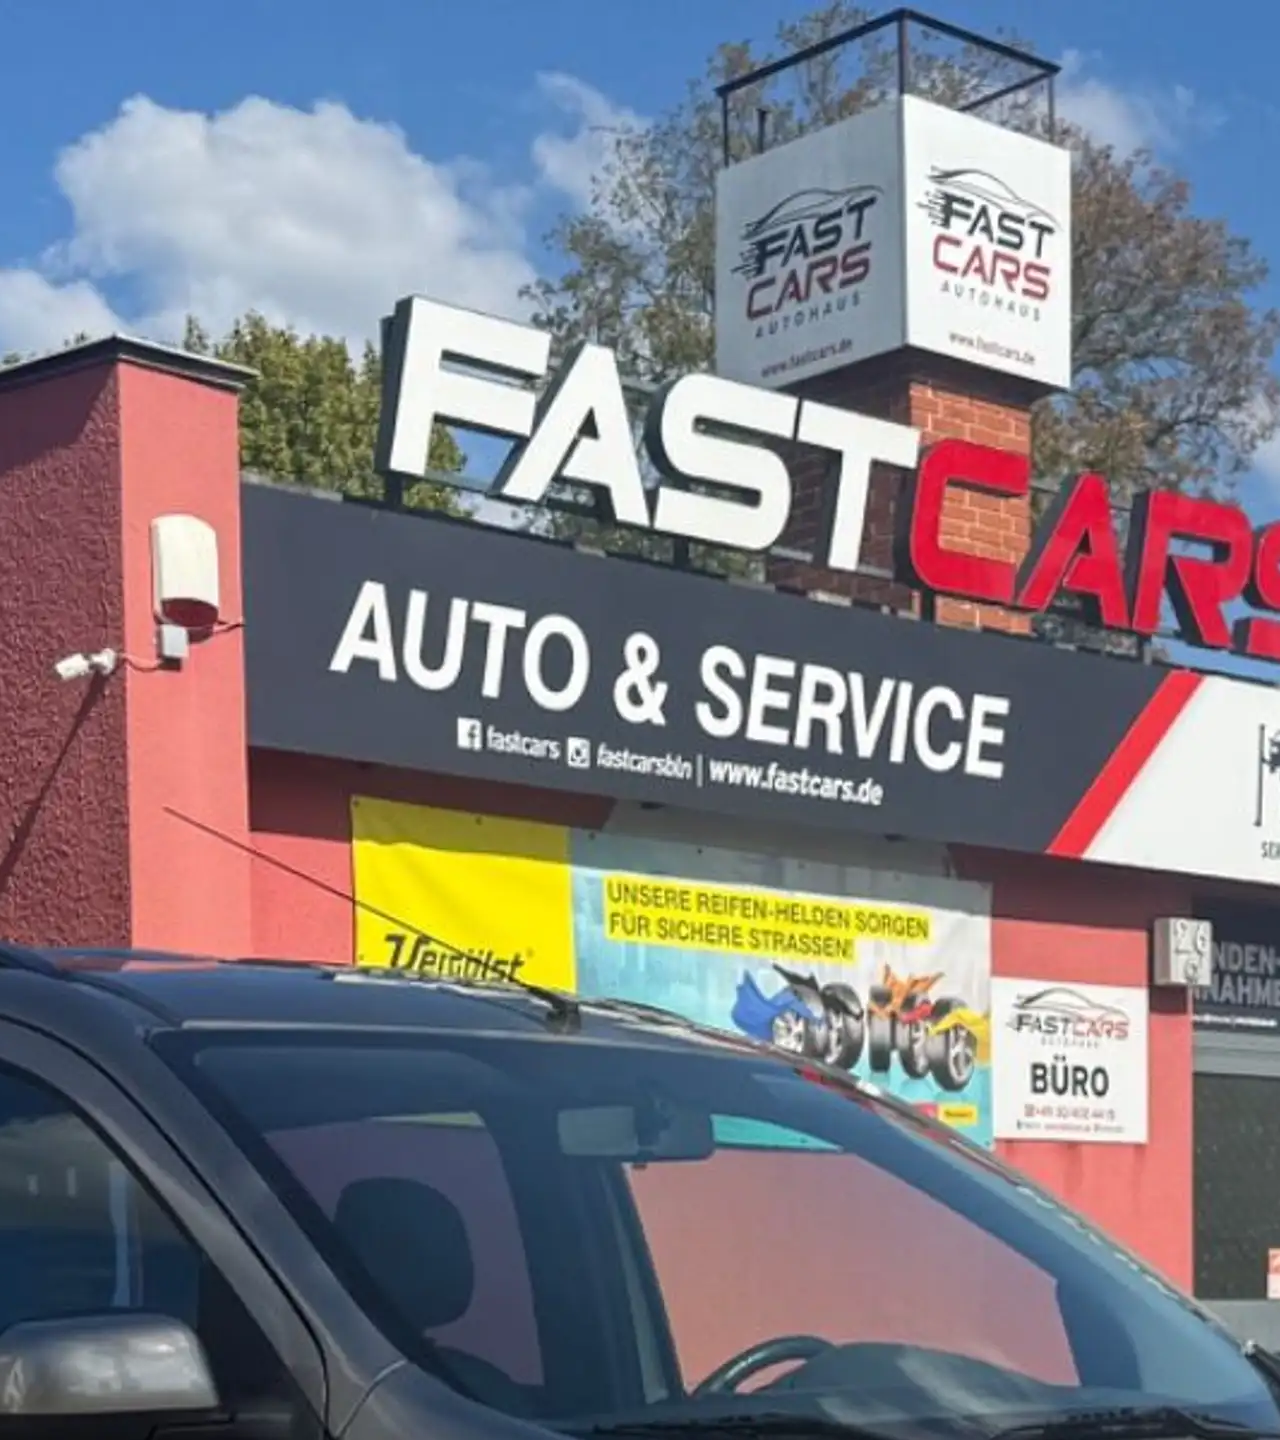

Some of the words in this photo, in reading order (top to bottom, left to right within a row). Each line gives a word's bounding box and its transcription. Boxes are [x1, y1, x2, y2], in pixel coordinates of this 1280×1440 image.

[753, 196, 877, 277] FAST
[940, 193, 1055, 259] FAST
[746, 241, 872, 320] CARS
[933, 233, 1050, 302] CARS
[755, 292, 861, 338] AUTOHAUS
[940, 282, 1041, 322] AUTOHAUS
[330, 579, 590, 711] AUTO
[613, 632, 668, 727] &
[695, 645, 1012, 780] SERVICE
[486, 724, 560, 759] fastcars
[708, 757, 884, 806] www.fastcars.de
[607, 880, 690, 912] UNSERE
[696, 892, 851, 930] REIFEN-HELDEN
[855, 911, 930, 940] SORGEN
[609, 908, 651, 937] FÜR
[656, 919, 743, 946] SICHERE
[747, 927, 853, 959] STRASSEN!
[1031, 1053, 1109, 1098] BÜRO
